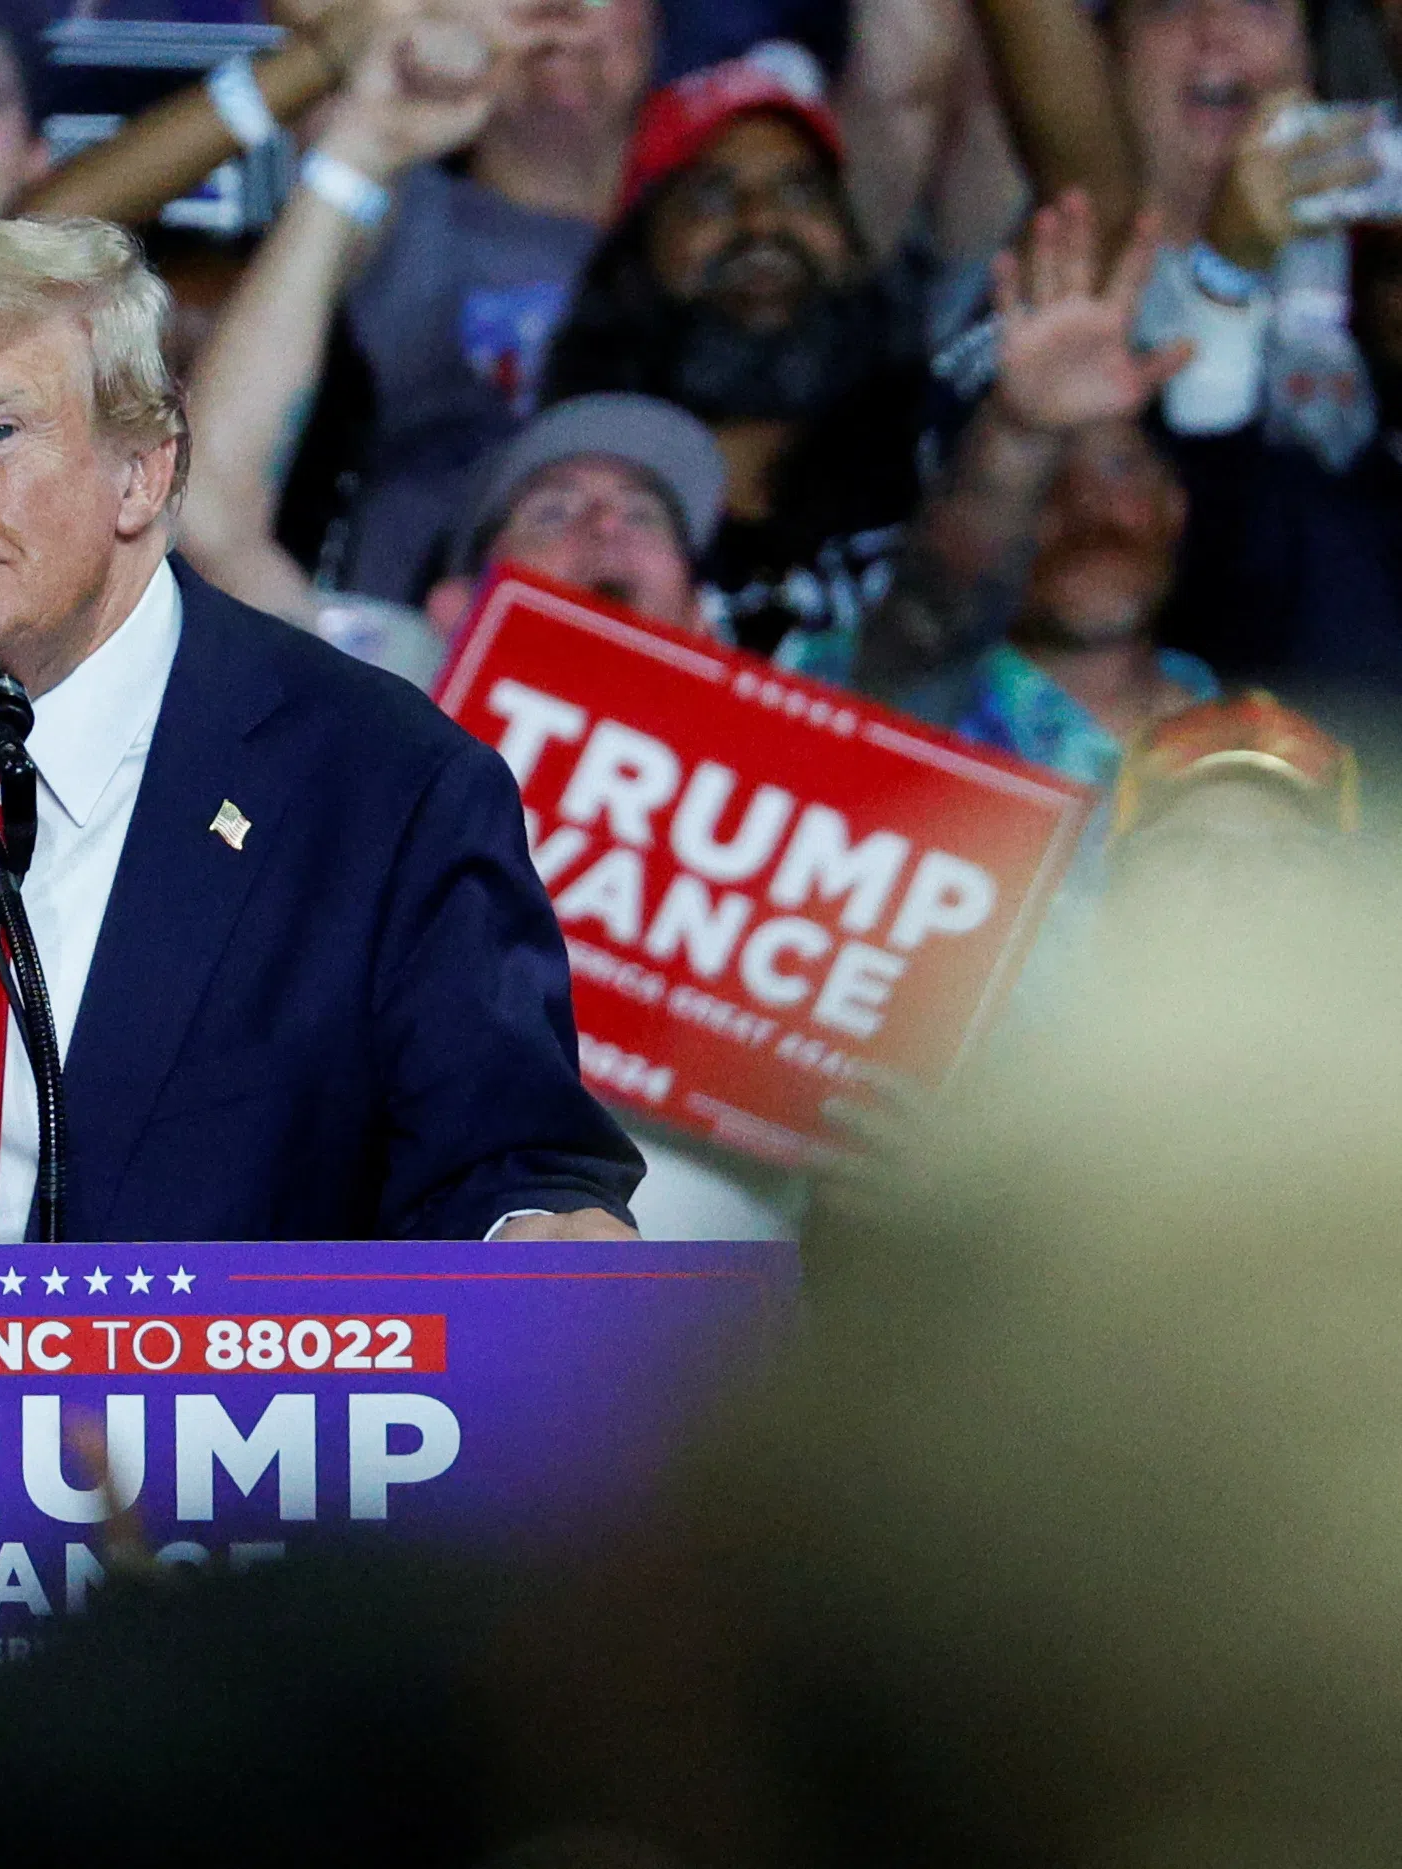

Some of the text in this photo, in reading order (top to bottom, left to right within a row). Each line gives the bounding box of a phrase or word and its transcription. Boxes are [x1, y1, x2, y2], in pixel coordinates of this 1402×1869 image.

[487, 678, 997, 950] TRUMP
[92, 1320, 182, 1371] TO
[204, 1318, 414, 1371] 88022
